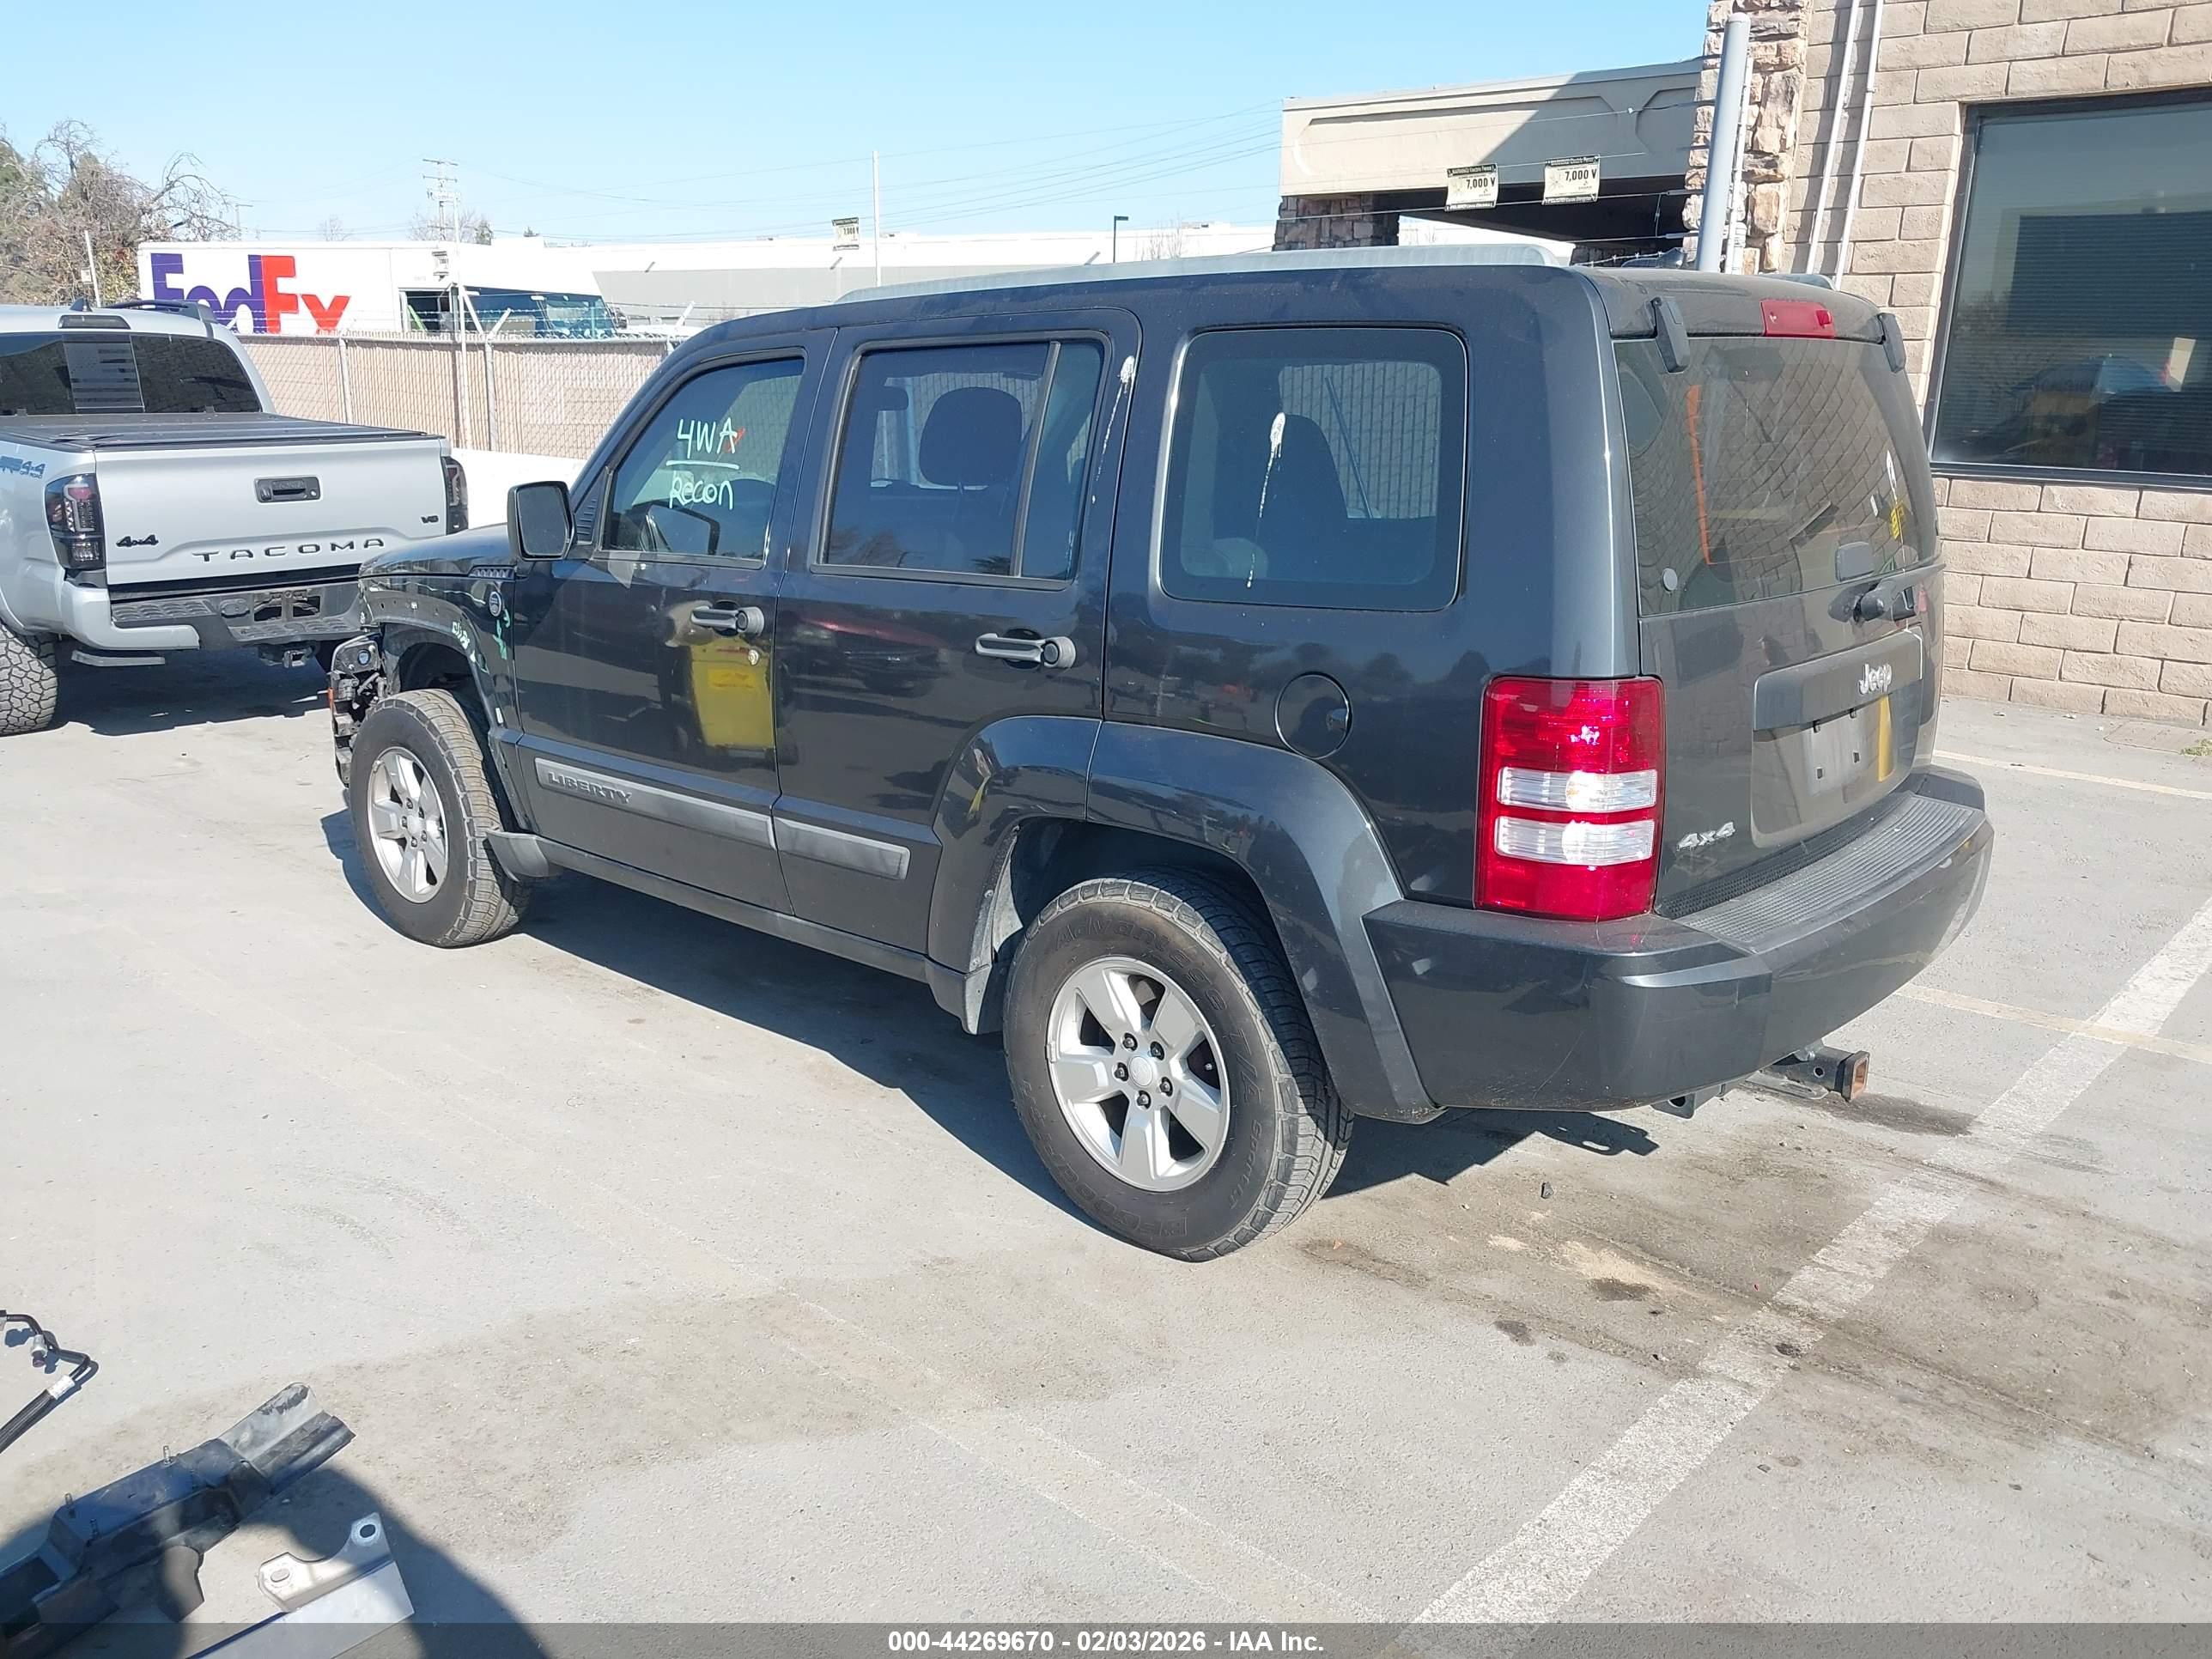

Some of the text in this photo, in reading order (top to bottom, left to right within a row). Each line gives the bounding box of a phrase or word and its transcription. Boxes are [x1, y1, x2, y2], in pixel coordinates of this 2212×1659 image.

[1466, 177, 1496, 190] 7,000 V
[1565, 169, 1589, 181] 7,000
[1590, 168, 1597, 179] V
[669, 471, 733, 511] Recon
[420, 515, 440, 524] V6
[115, 533, 160, 548] 4x4
[191, 538, 385, 563] TACOMA
[1857, 663, 1893, 695] Jeep
[548, 771, 633, 805] LIBERTY
